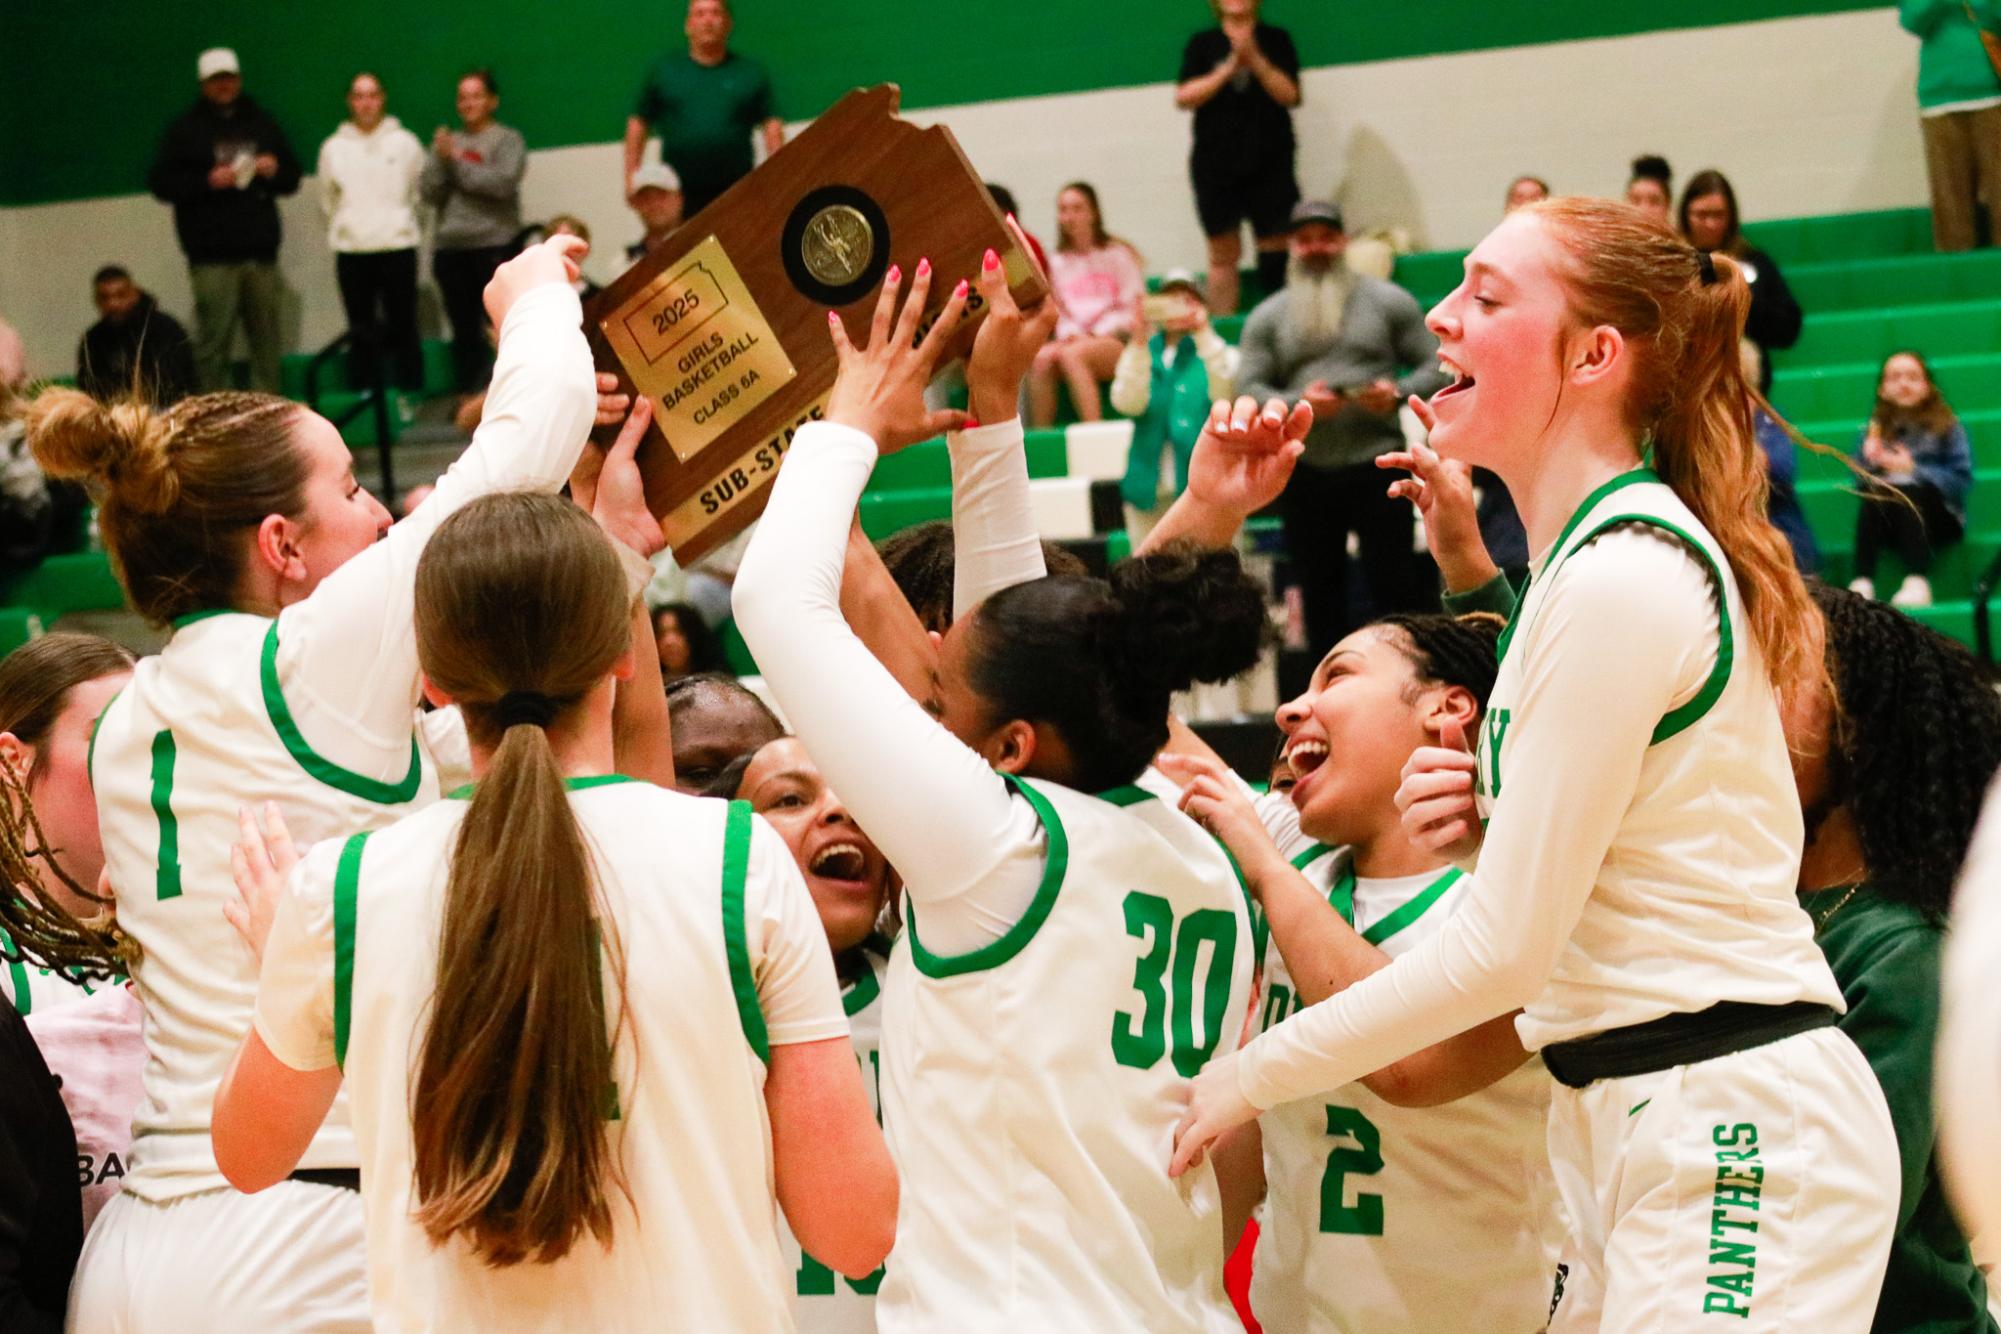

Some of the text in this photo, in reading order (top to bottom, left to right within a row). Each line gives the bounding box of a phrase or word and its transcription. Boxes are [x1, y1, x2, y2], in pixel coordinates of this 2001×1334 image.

[652, 288, 700, 337] 2025
[677, 331, 724, 375] GIRLS
[661, 331, 759, 411] BASKETBALL
[693, 369, 761, 425] CLASS 6A
[150, 727, 183, 901] 1
[1111, 889, 1238, 1080] 30
[1319, 1103, 1385, 1236] 2
[1702, 1122, 1765, 1319] PANTHERS
